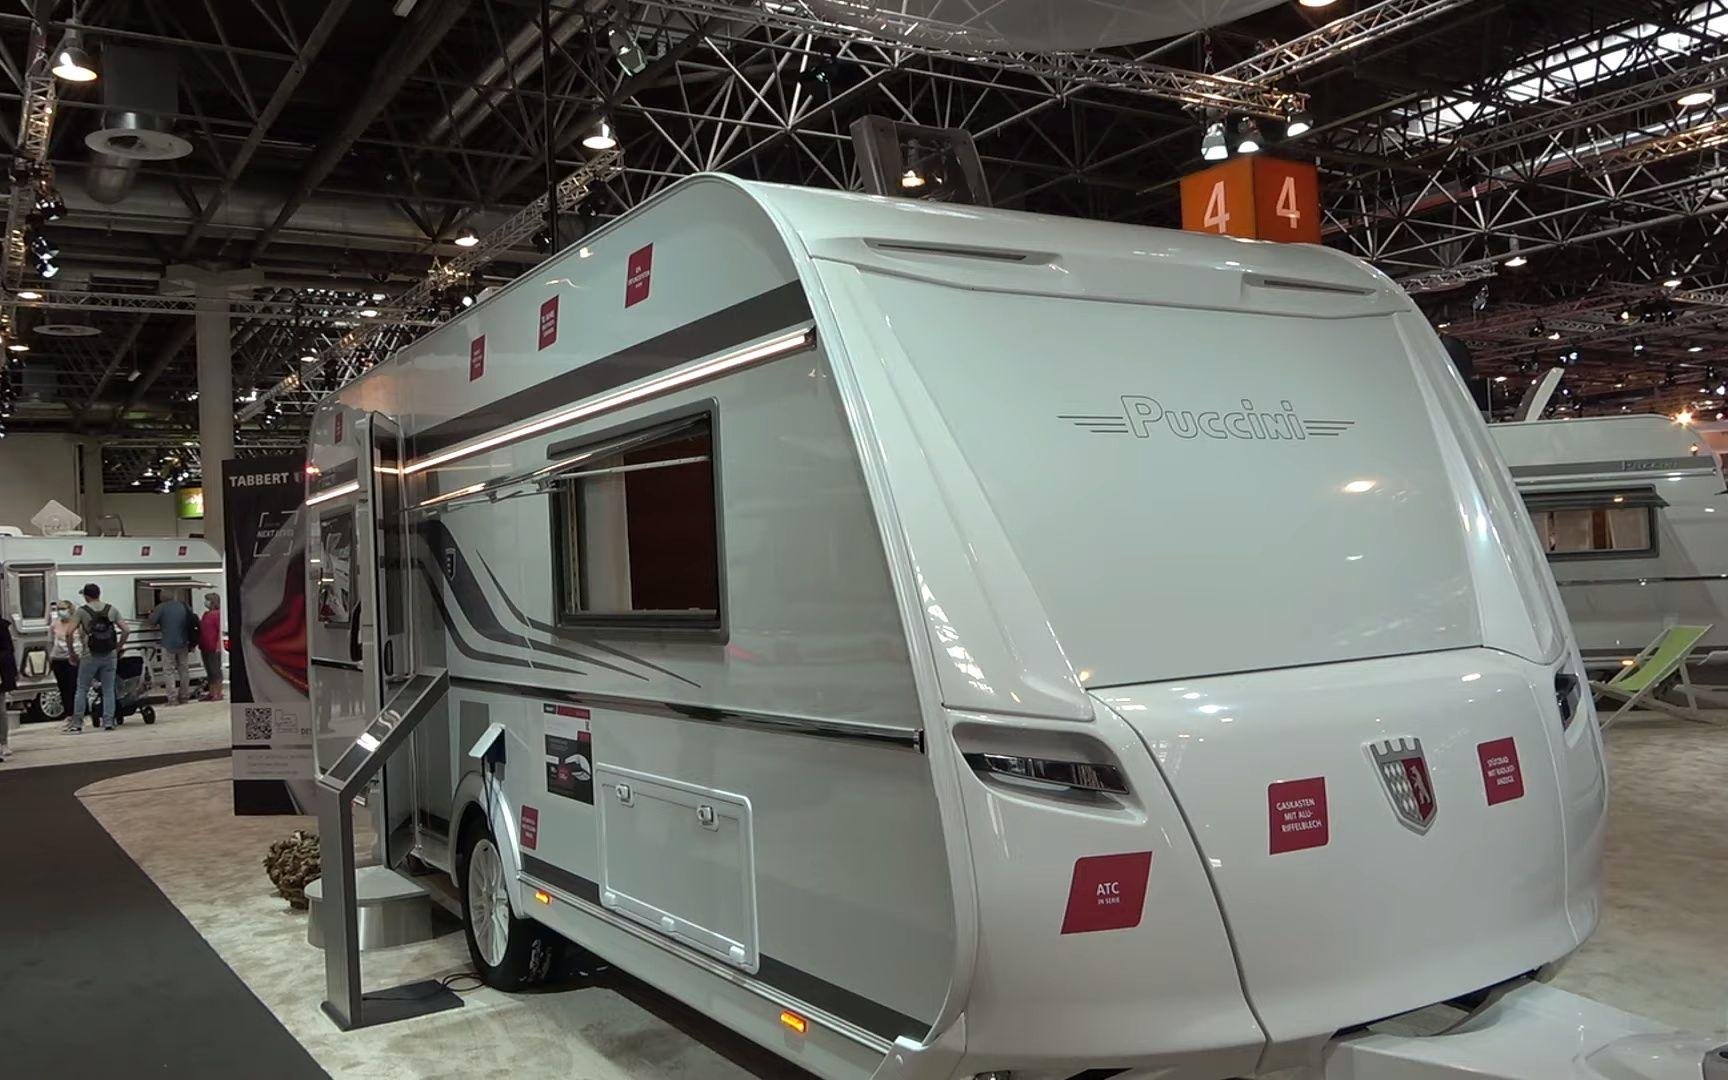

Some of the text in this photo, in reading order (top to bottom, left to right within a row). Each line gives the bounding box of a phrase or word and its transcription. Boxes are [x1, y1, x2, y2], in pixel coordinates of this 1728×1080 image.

[1203, 180, 1230, 233] 4
[1276, 176, 1300, 229] 4
[1121, 395, 1305, 440] Puccini
[229, 472, 290, 488] TABBERT
[1284, 811, 1297, 821] MIT
[1096, 881, 1120, 896] ATC
[1105, 897, 1120, 905] SERIE
